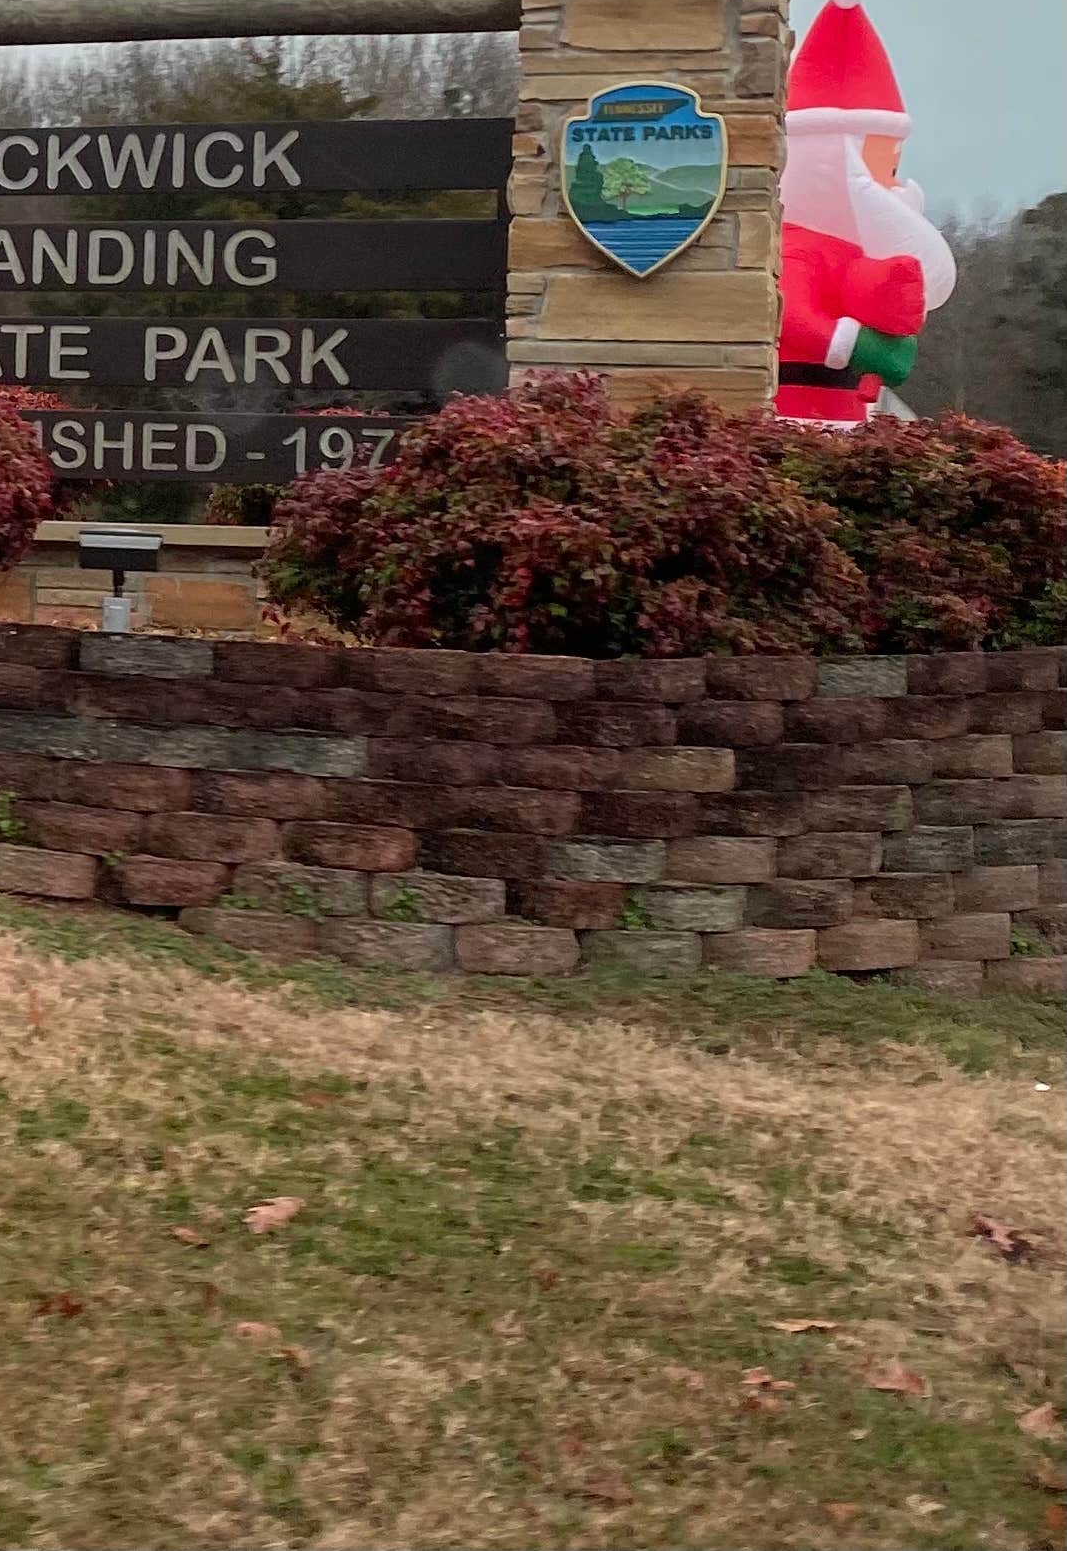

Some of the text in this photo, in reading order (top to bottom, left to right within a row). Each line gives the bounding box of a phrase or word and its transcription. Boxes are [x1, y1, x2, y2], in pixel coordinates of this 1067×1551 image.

[571, 124, 713, 142] STATE PARKS
[144, 326, 350, 385] PARK
